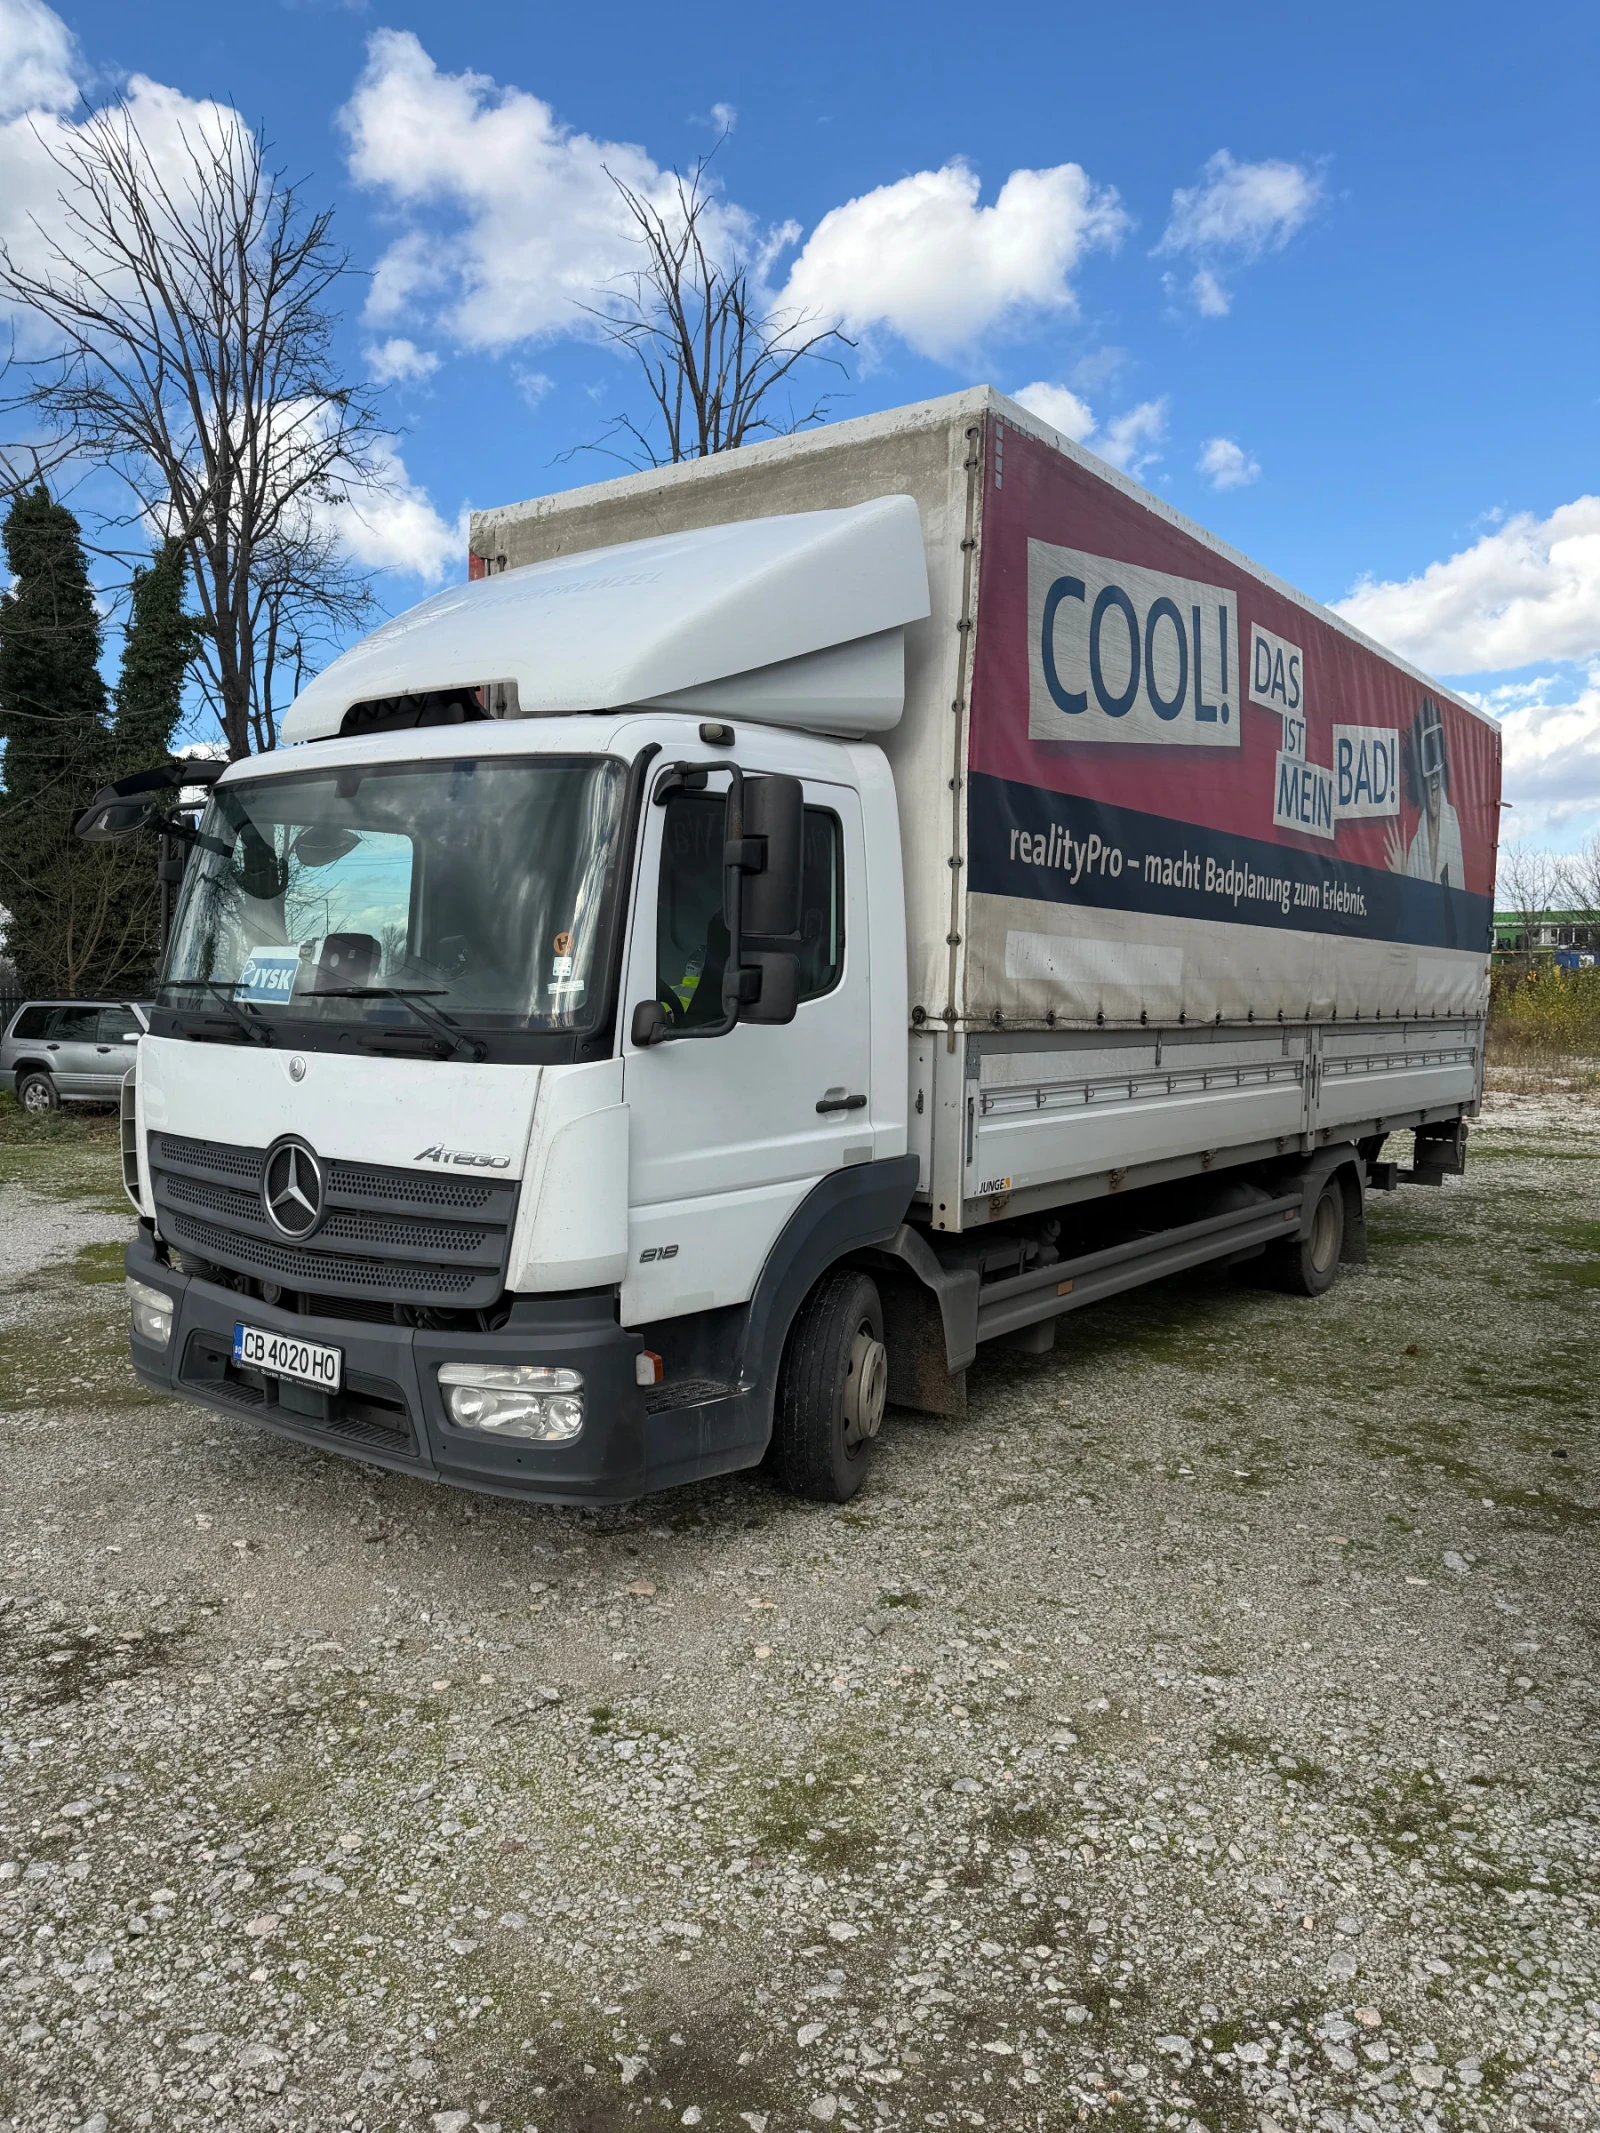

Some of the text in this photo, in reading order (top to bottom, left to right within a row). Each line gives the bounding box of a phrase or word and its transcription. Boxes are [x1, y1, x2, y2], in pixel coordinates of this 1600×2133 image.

[1042, 575, 1229, 725] COOL!
[1255, 636, 1300, 709] DAS
[1284, 716, 1304, 755] IST
[1277, 763, 1333, 829] MEIN
[1338, 738, 1395, 806] BAD!
[1010, 823, 1122, 885] realityPro
[1145, 850, 1201, 890] macht
[1205, 857, 1291, 914] Badplanung
[1294, 882, 1319, 908] zum
[1322, 880, 1367, 916] Erlebnis.
[249, 968, 294, 990] JYSK
[979, 1178, 1005, 1194] JUNGE
[639, 1244, 679, 1263] 818
[244, 1332, 335, 1381] CB 4020 HO
